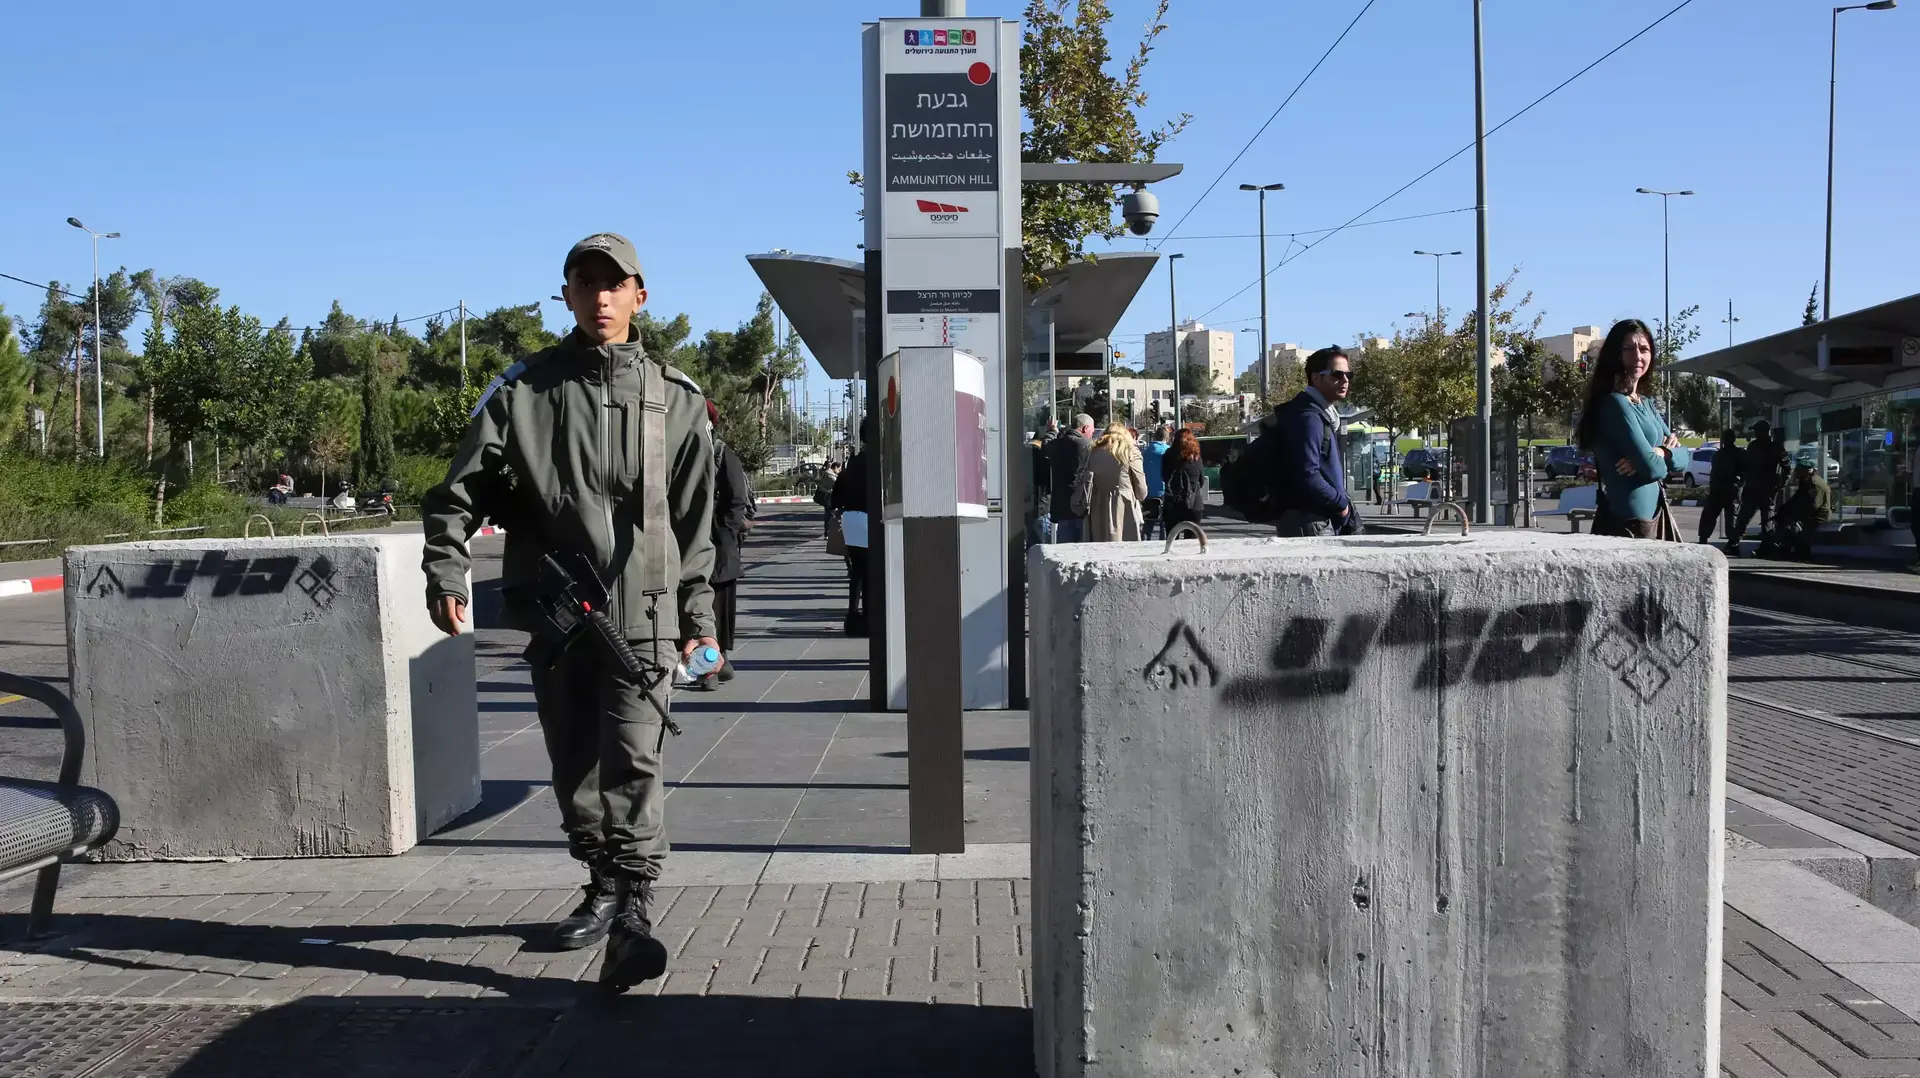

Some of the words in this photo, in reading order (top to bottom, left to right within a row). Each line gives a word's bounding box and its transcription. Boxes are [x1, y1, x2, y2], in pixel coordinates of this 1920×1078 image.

[917, 93, 968, 109] גבעת
[892, 123, 993, 138] התחמושת
[892, 175, 966, 185] AMMUNITION
[969, 175, 993, 185] HILL
[952, 291, 973, 299] לכיוון
